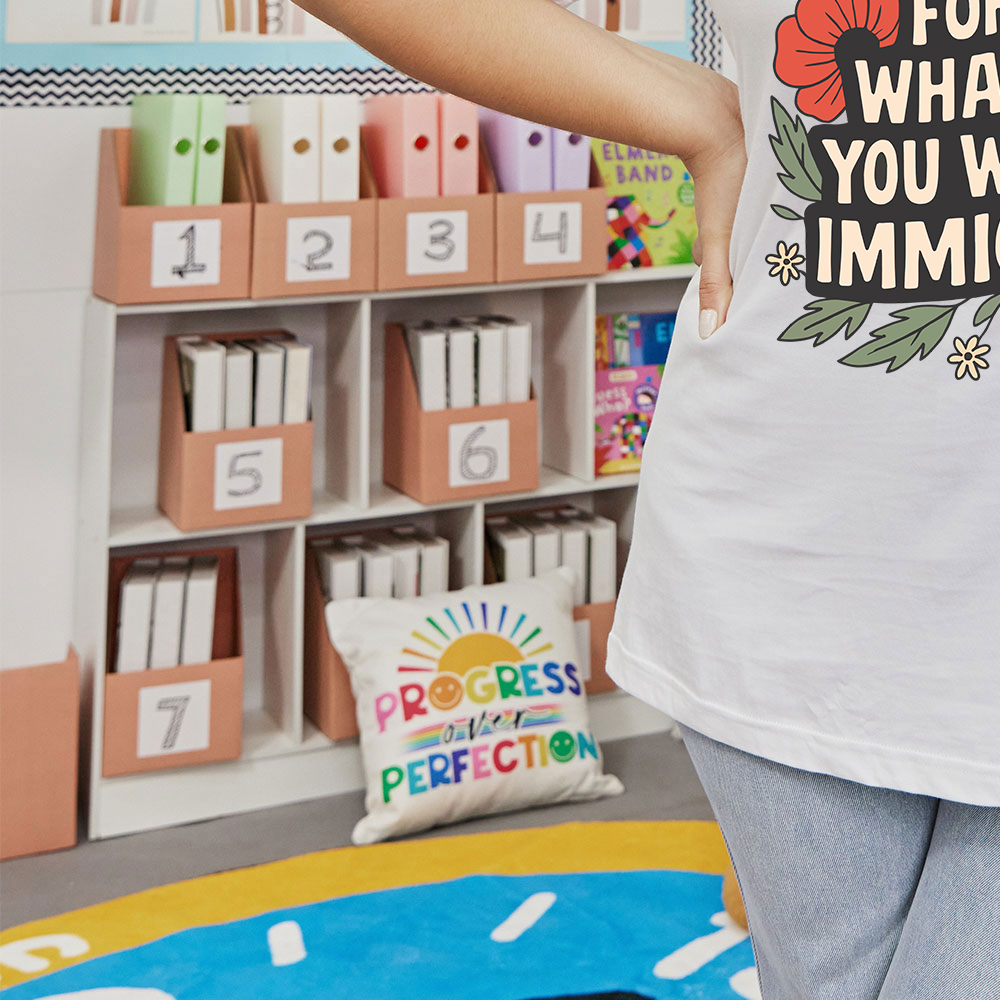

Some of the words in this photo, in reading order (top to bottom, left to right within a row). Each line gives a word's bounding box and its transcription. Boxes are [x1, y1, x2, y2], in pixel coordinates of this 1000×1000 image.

[616, 165, 672, 184] BAND
[821, 138, 940, 205] YOU
[172, 224, 206, 278] 1
[303, 229, 334, 271] 2
[424, 218, 456, 261] 3
[532, 211, 567, 254] 4
[227, 450, 263, 497] 5
[458, 424, 498, 481] 6
[156, 694, 191, 750] 7
[375, 661, 581, 734] PROGRESS
[442, 708, 529, 744] over
[381, 730, 598, 804] PERFECTION
